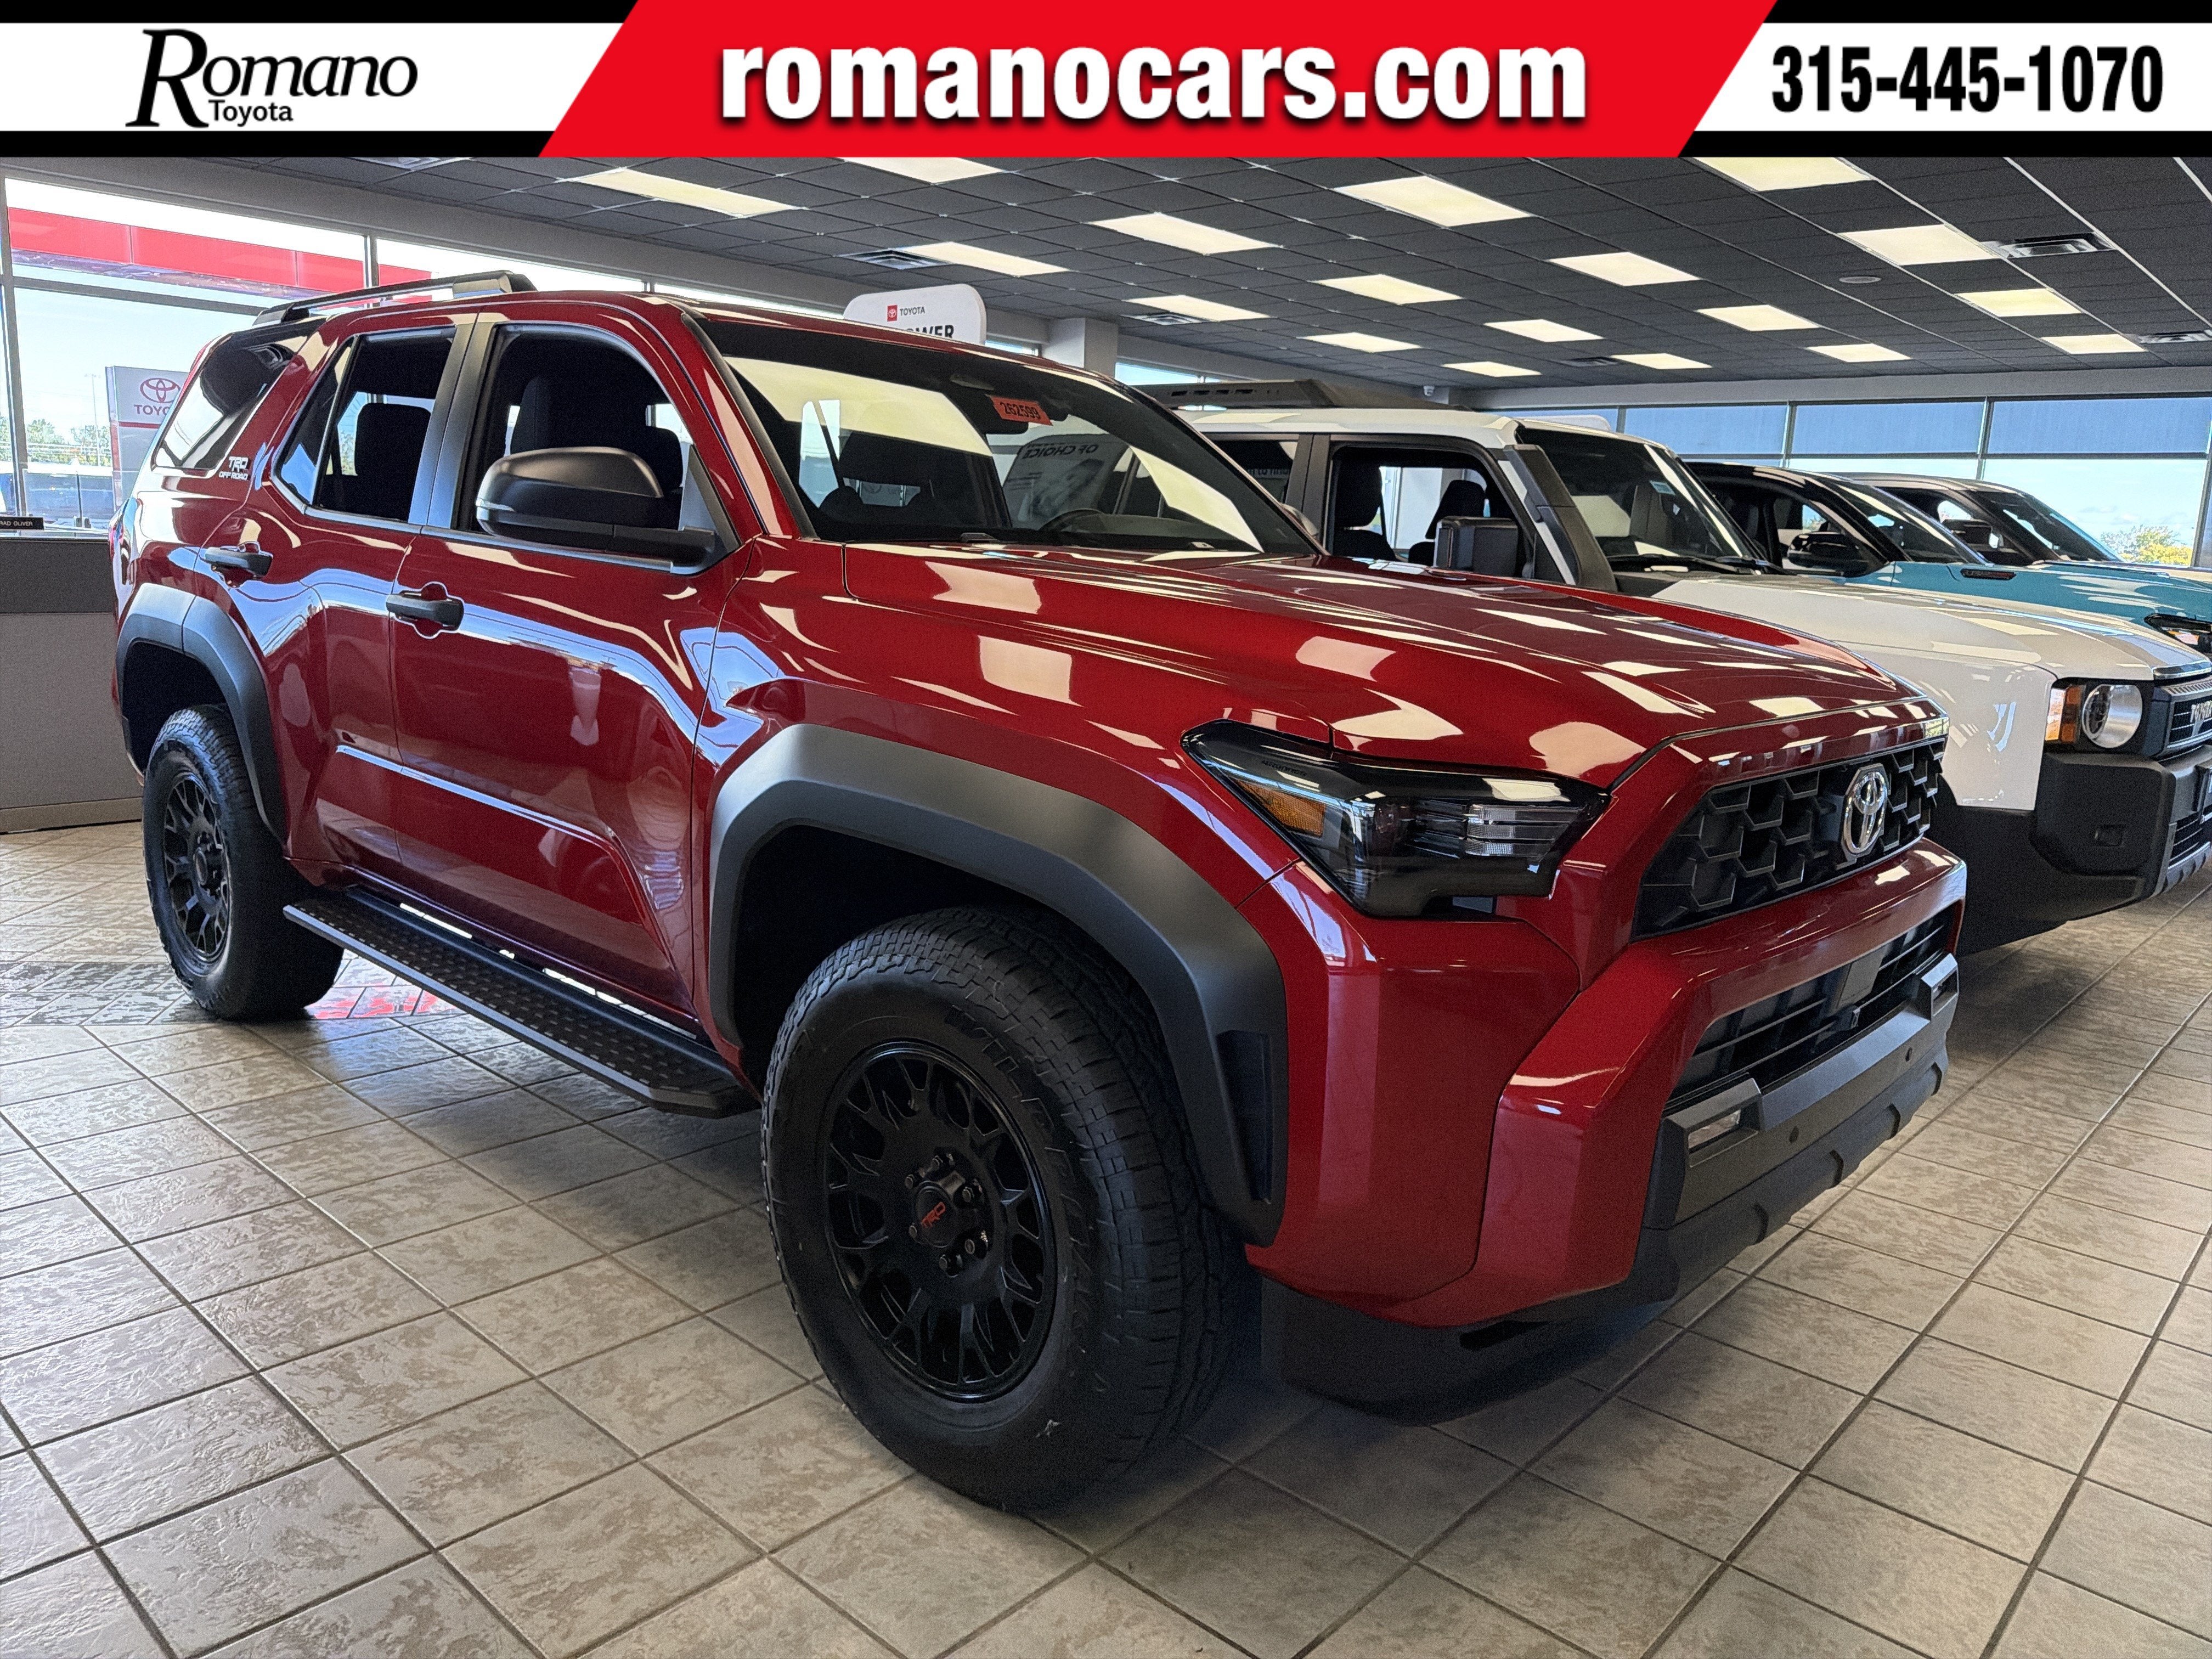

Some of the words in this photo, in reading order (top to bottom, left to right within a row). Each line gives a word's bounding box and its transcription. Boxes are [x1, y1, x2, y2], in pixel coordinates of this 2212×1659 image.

[900, 306, 926, 316] TOYOTA
[1000, 402, 1041, 419] 262599
[229, 456, 249, 472] TRD
[231, 472, 249, 481] ROAD
[921, 1201, 946, 1229] TRD
